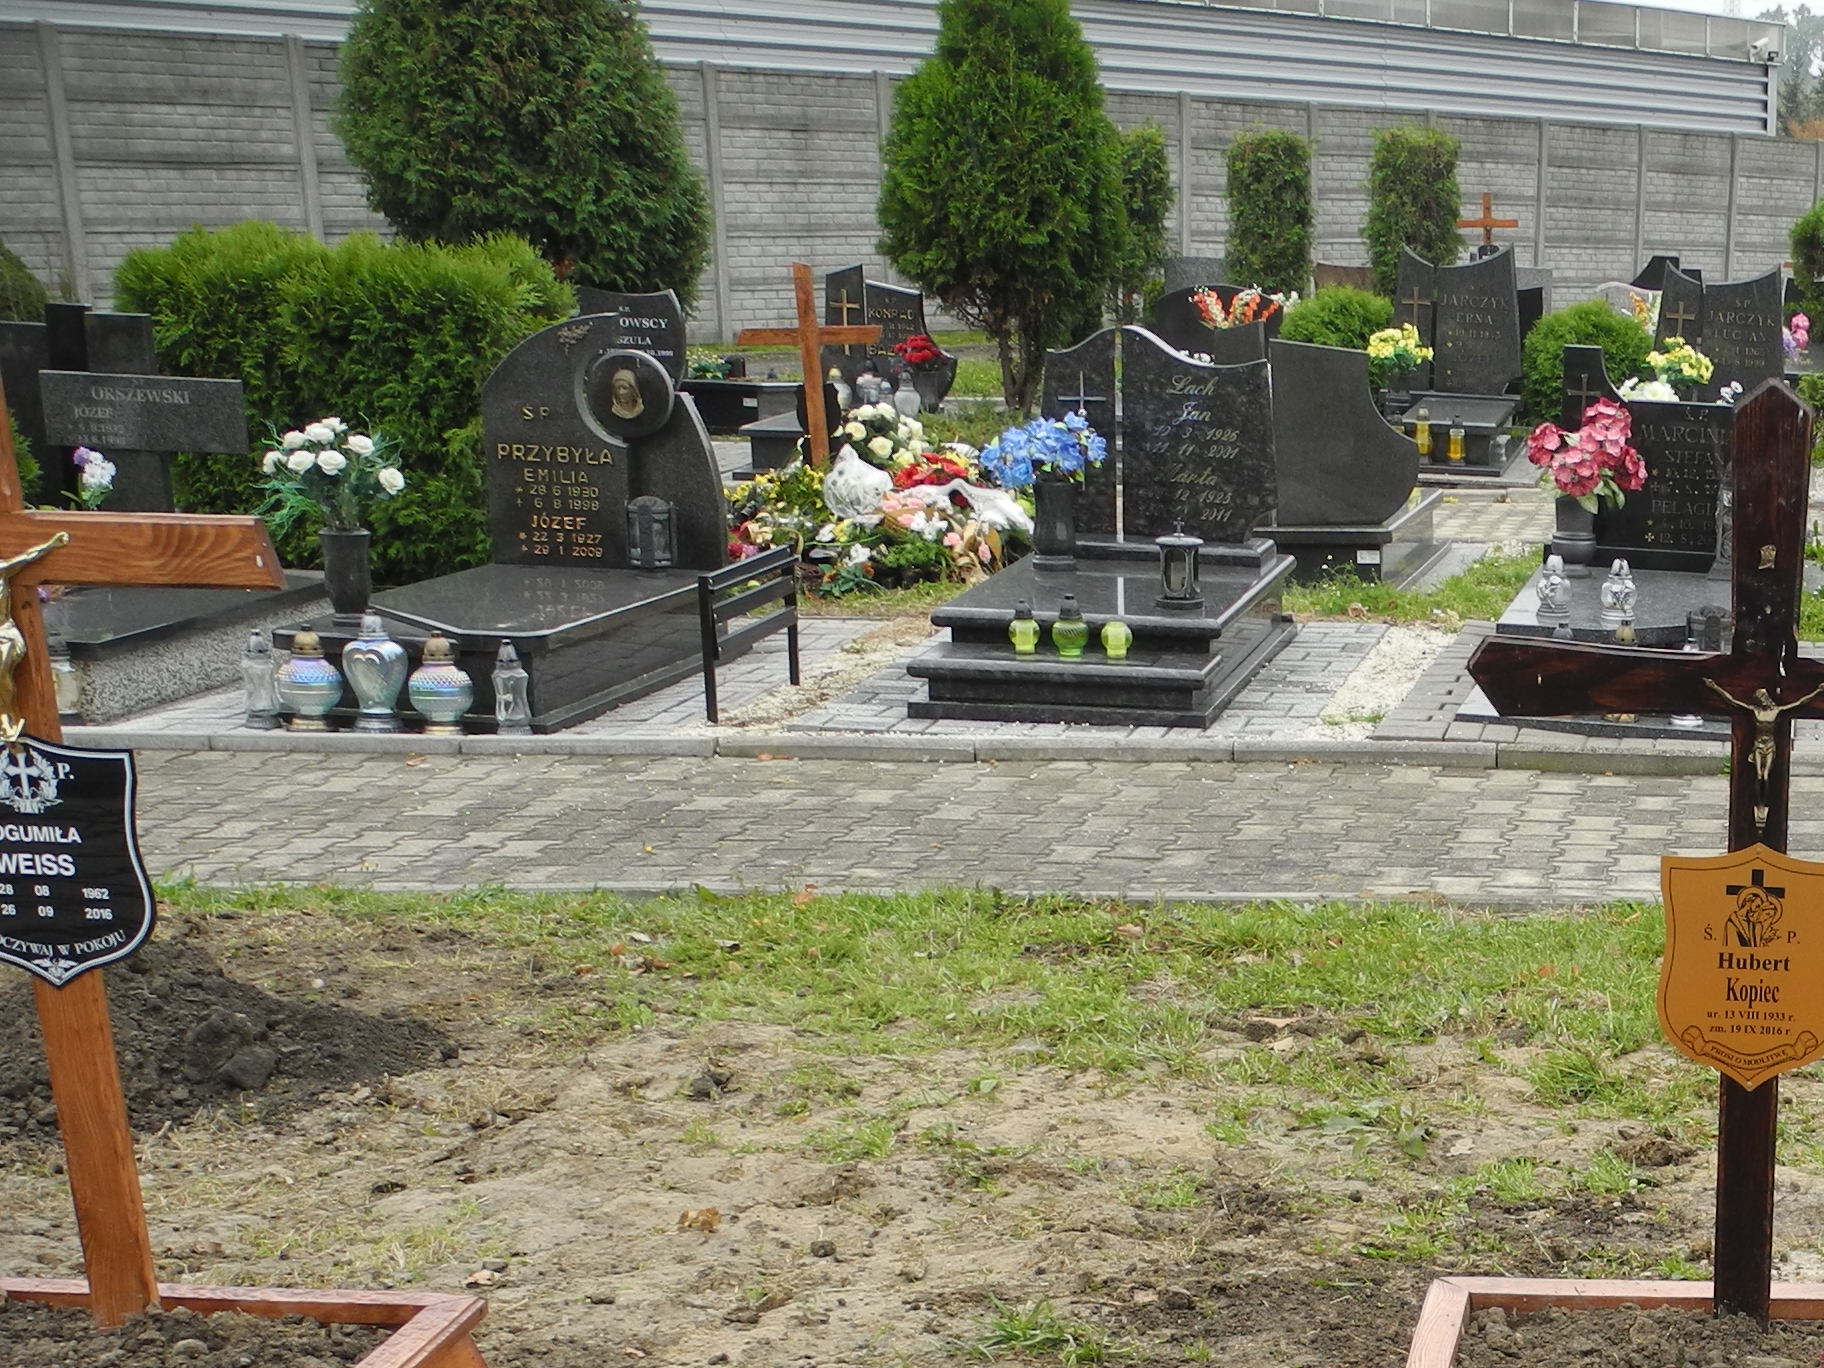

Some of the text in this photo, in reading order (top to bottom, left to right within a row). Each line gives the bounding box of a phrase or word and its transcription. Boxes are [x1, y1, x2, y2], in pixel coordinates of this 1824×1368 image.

[619, 316, 668, 329] OWSCY
[617, 335, 652, 346] SZULA
[497, 442, 613, 465] PRZYBYŁA
[523, 468, 589, 484] EMILIA
[531, 512, 587, 530] JÓZEF
[56, 762, 75, 780] P.
[0, 853, 76, 876] WEISS
[0, 883, 109, 900] 28 08 1962
[1, 903, 113, 920] 26 09 2016
[57, 943, 71, 956] W
[74, 928, 127, 955] POKOJU
[1717, 952, 1791, 972] Hubert
[1725, 977, 1780, 1008] Kopiec
